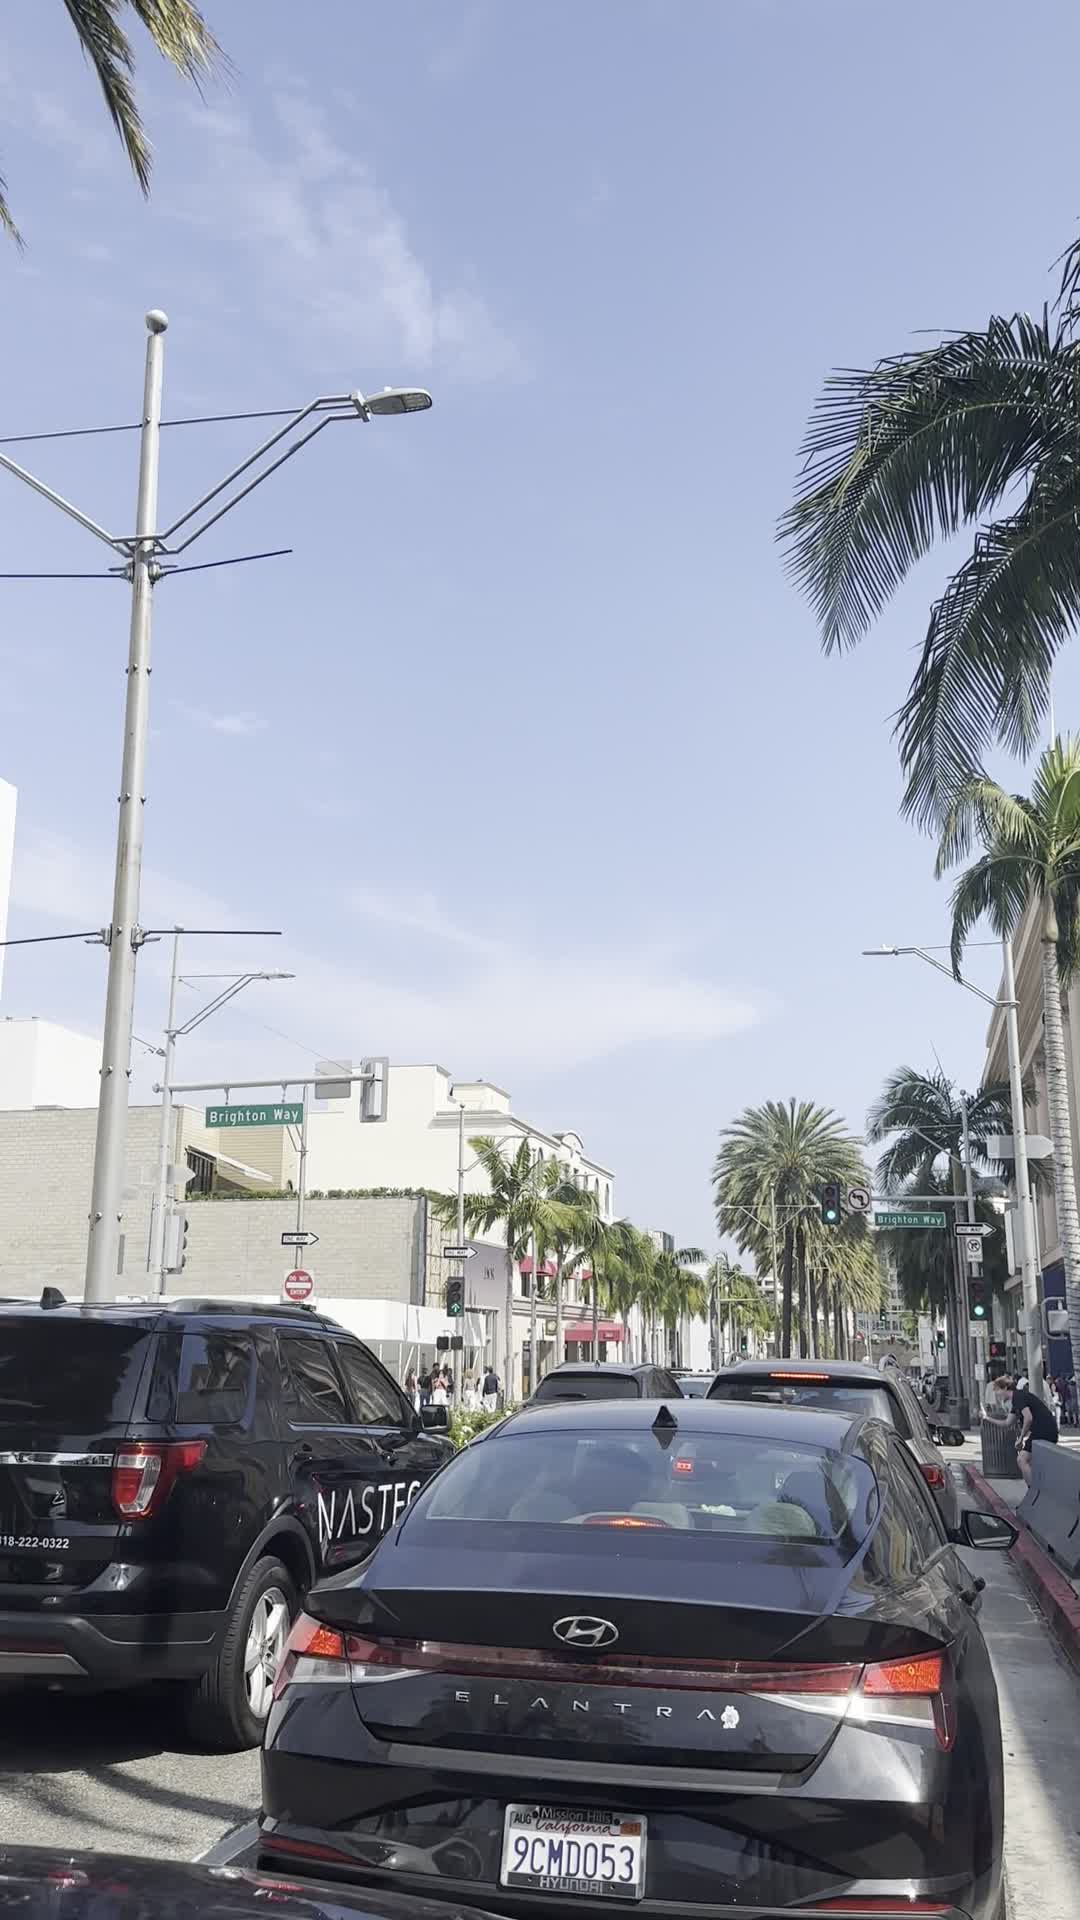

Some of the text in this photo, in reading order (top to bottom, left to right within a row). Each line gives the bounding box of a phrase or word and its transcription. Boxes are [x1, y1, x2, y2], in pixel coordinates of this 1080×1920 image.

[209, 1108, 299, 1126] Brighton Way
[877, 1215, 942, 1226] Brighton Way
[455, 1691, 716, 1721] ELANTRA
[513, 1807, 612, 1825] AUG Mission Hills
[535, 1818, 612, 1837] California
[514, 1836, 635, 1883] 9CMD053
[539, 1876, 604, 1893] HYUNDAI
